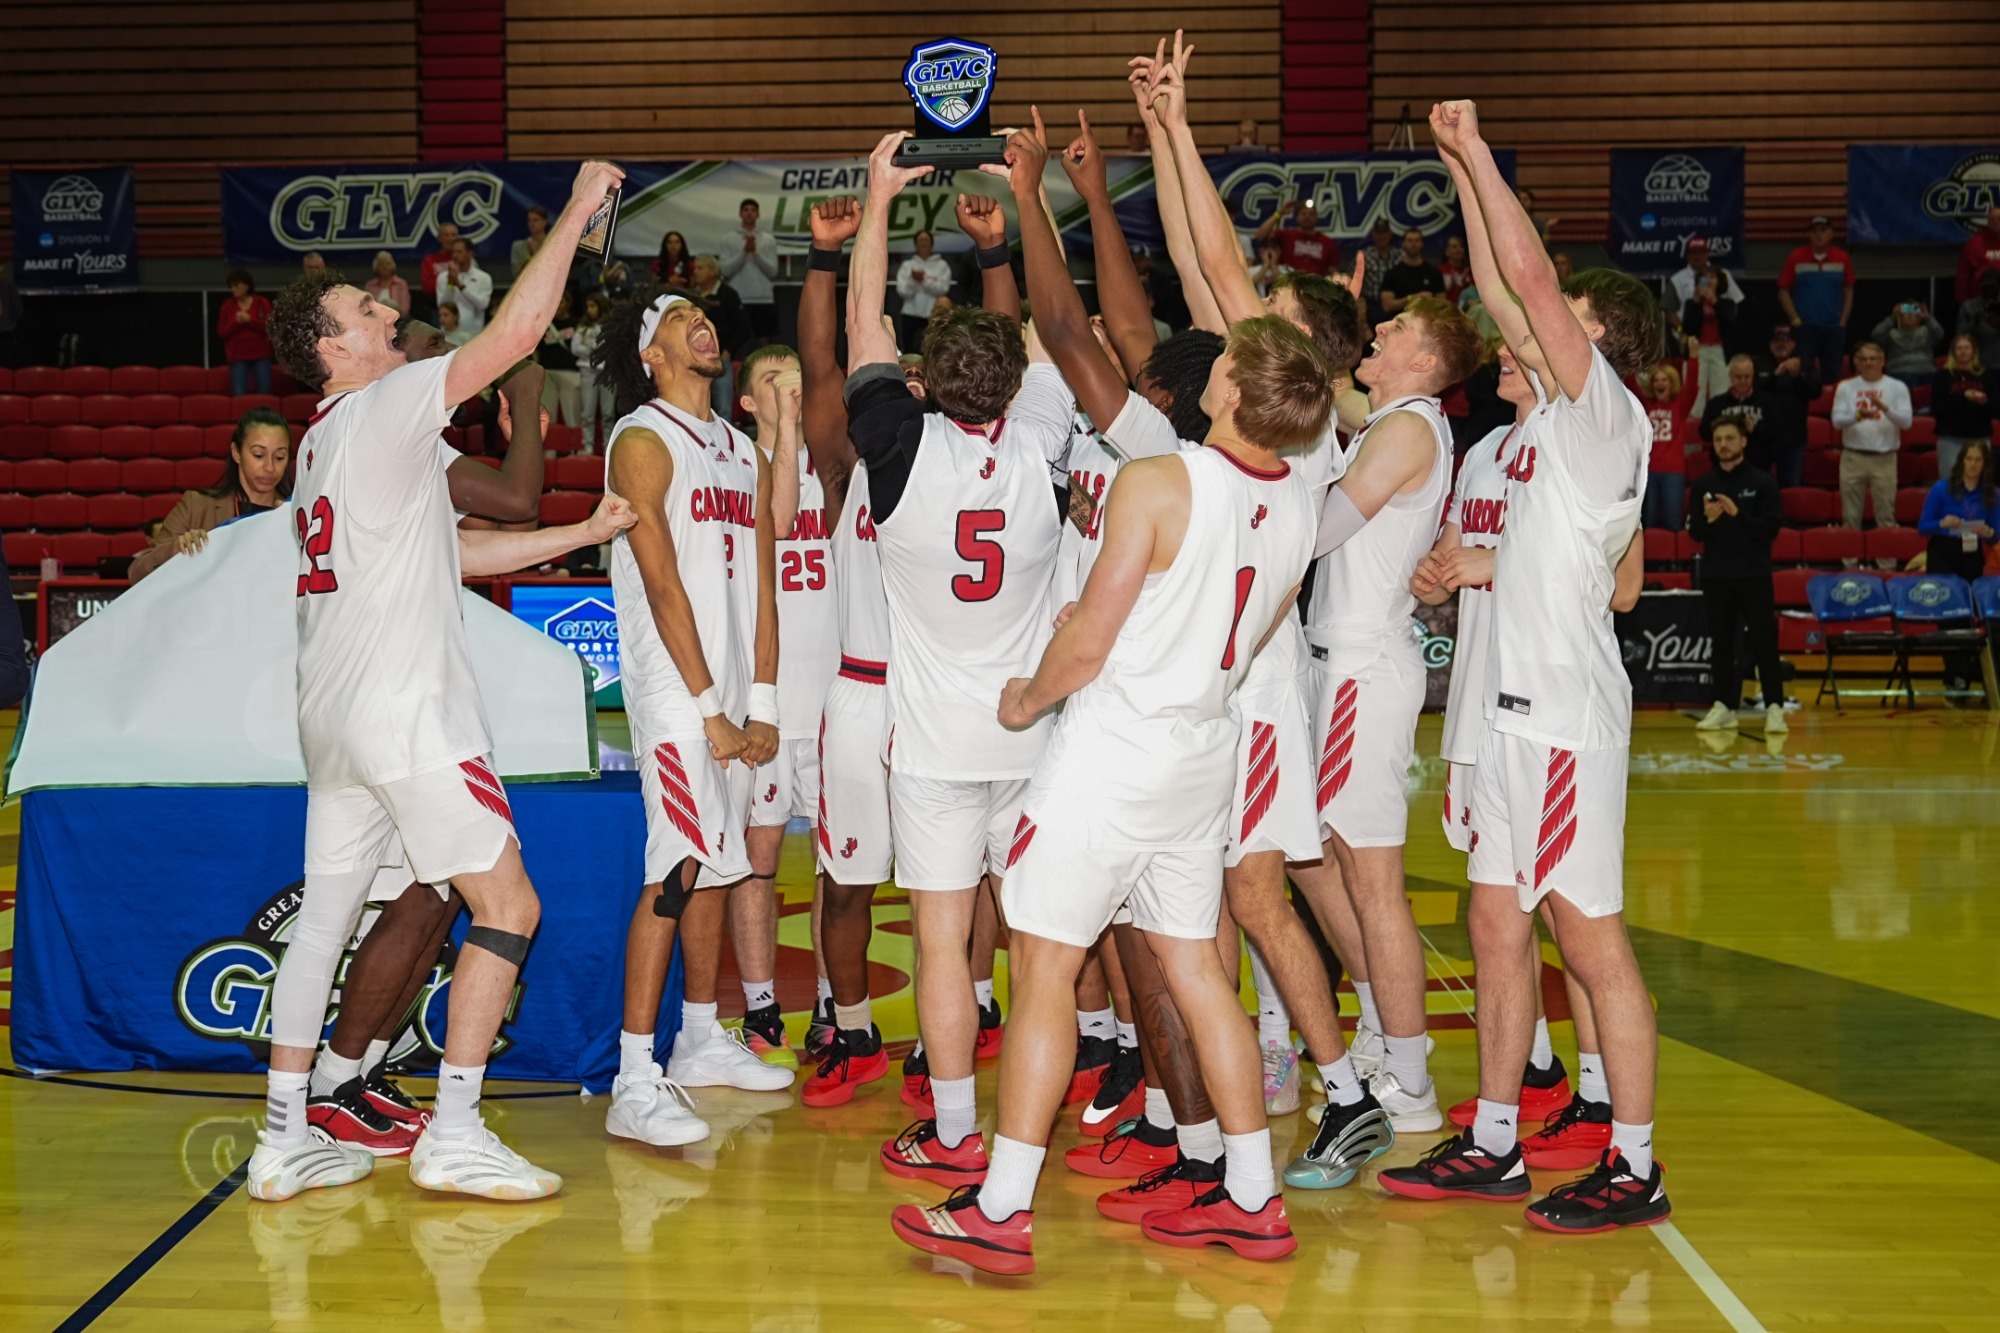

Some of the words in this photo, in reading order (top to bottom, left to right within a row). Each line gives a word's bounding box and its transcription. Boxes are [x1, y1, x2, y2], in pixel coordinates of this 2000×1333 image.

[912, 56, 989, 84] GLVC
[922, 81, 982, 93] BASKETBALL
[1644, 170, 1711, 193] GLVC
[42, 192, 103, 213] GLVC
[1216, 160, 1457, 239] GLVC
[1645, 193, 1709, 203] BASKETBALL
[44, 213, 103, 222] BASKETBALL
[271, 170, 500, 251] GLVC
[1622, 241, 1661, 253] MAKE
[1663, 240, 1677, 252] IT
[24, 259, 50, 270] MAKE
[52, 258, 64, 268] IT
[64, 249, 127, 274] YOURS
[951, 509, 1006, 603] 5
[781, 549, 826, 592] 25
